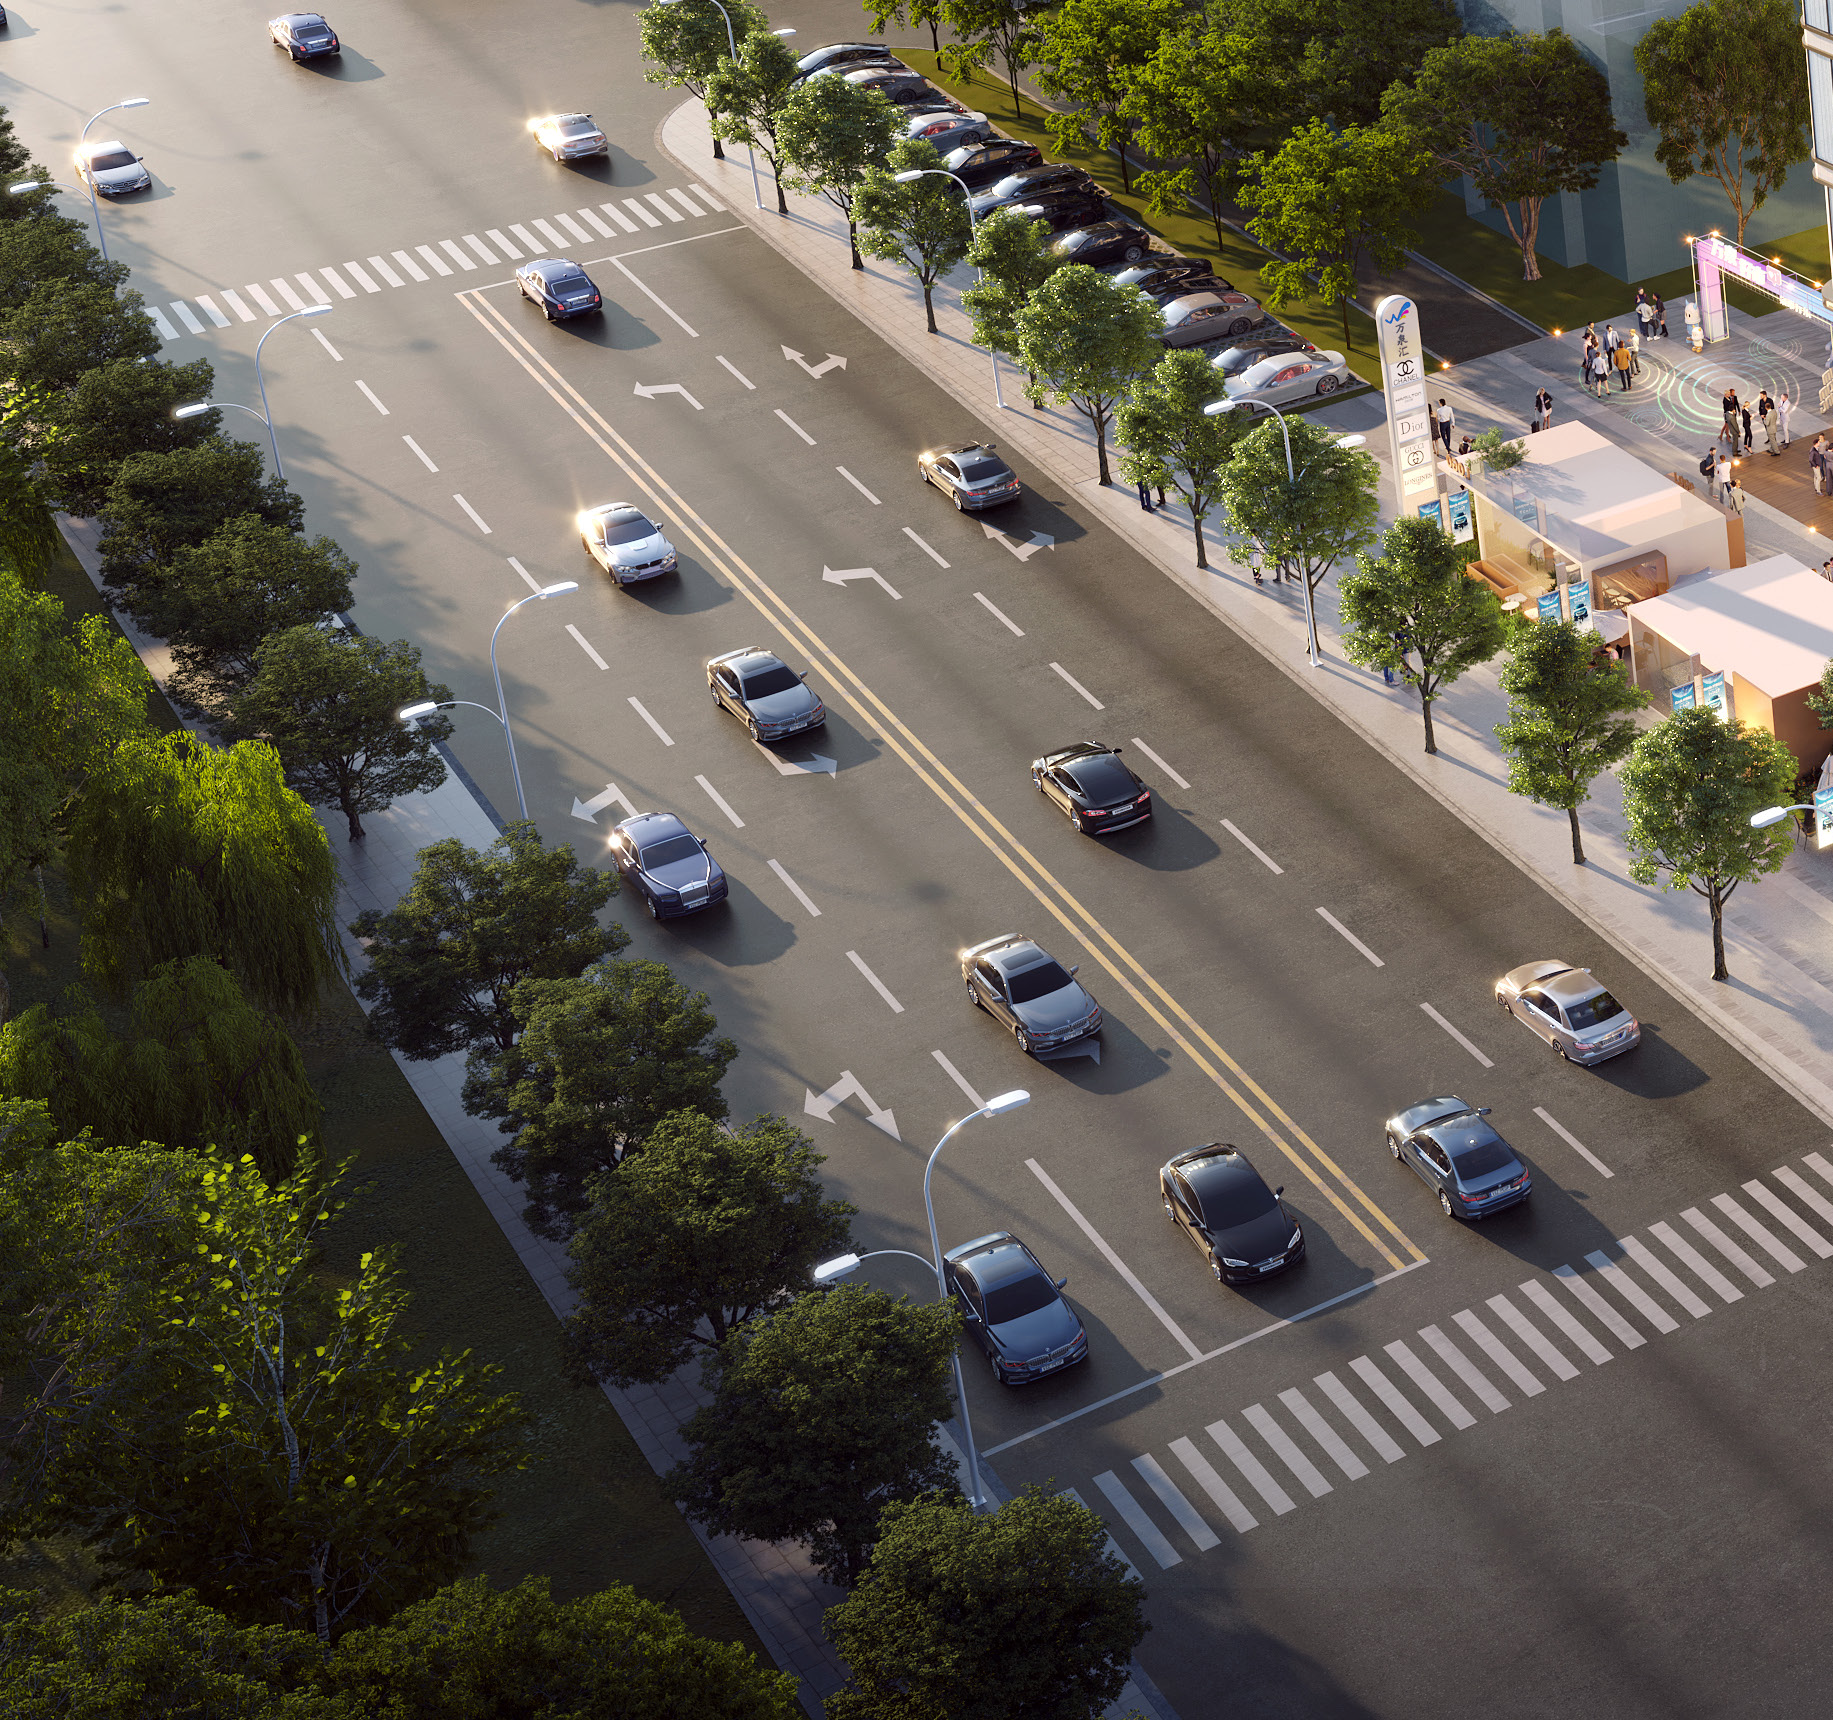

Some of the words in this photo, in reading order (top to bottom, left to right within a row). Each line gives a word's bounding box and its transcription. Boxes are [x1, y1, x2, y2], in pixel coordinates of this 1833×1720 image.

[1395, 322, 1410, 358] 万泉汇
[1393, 374, 1420, 386] CHANEL
[1400, 421, 1424, 436] Dior
[1404, 441, 1425, 454] GUCCI
